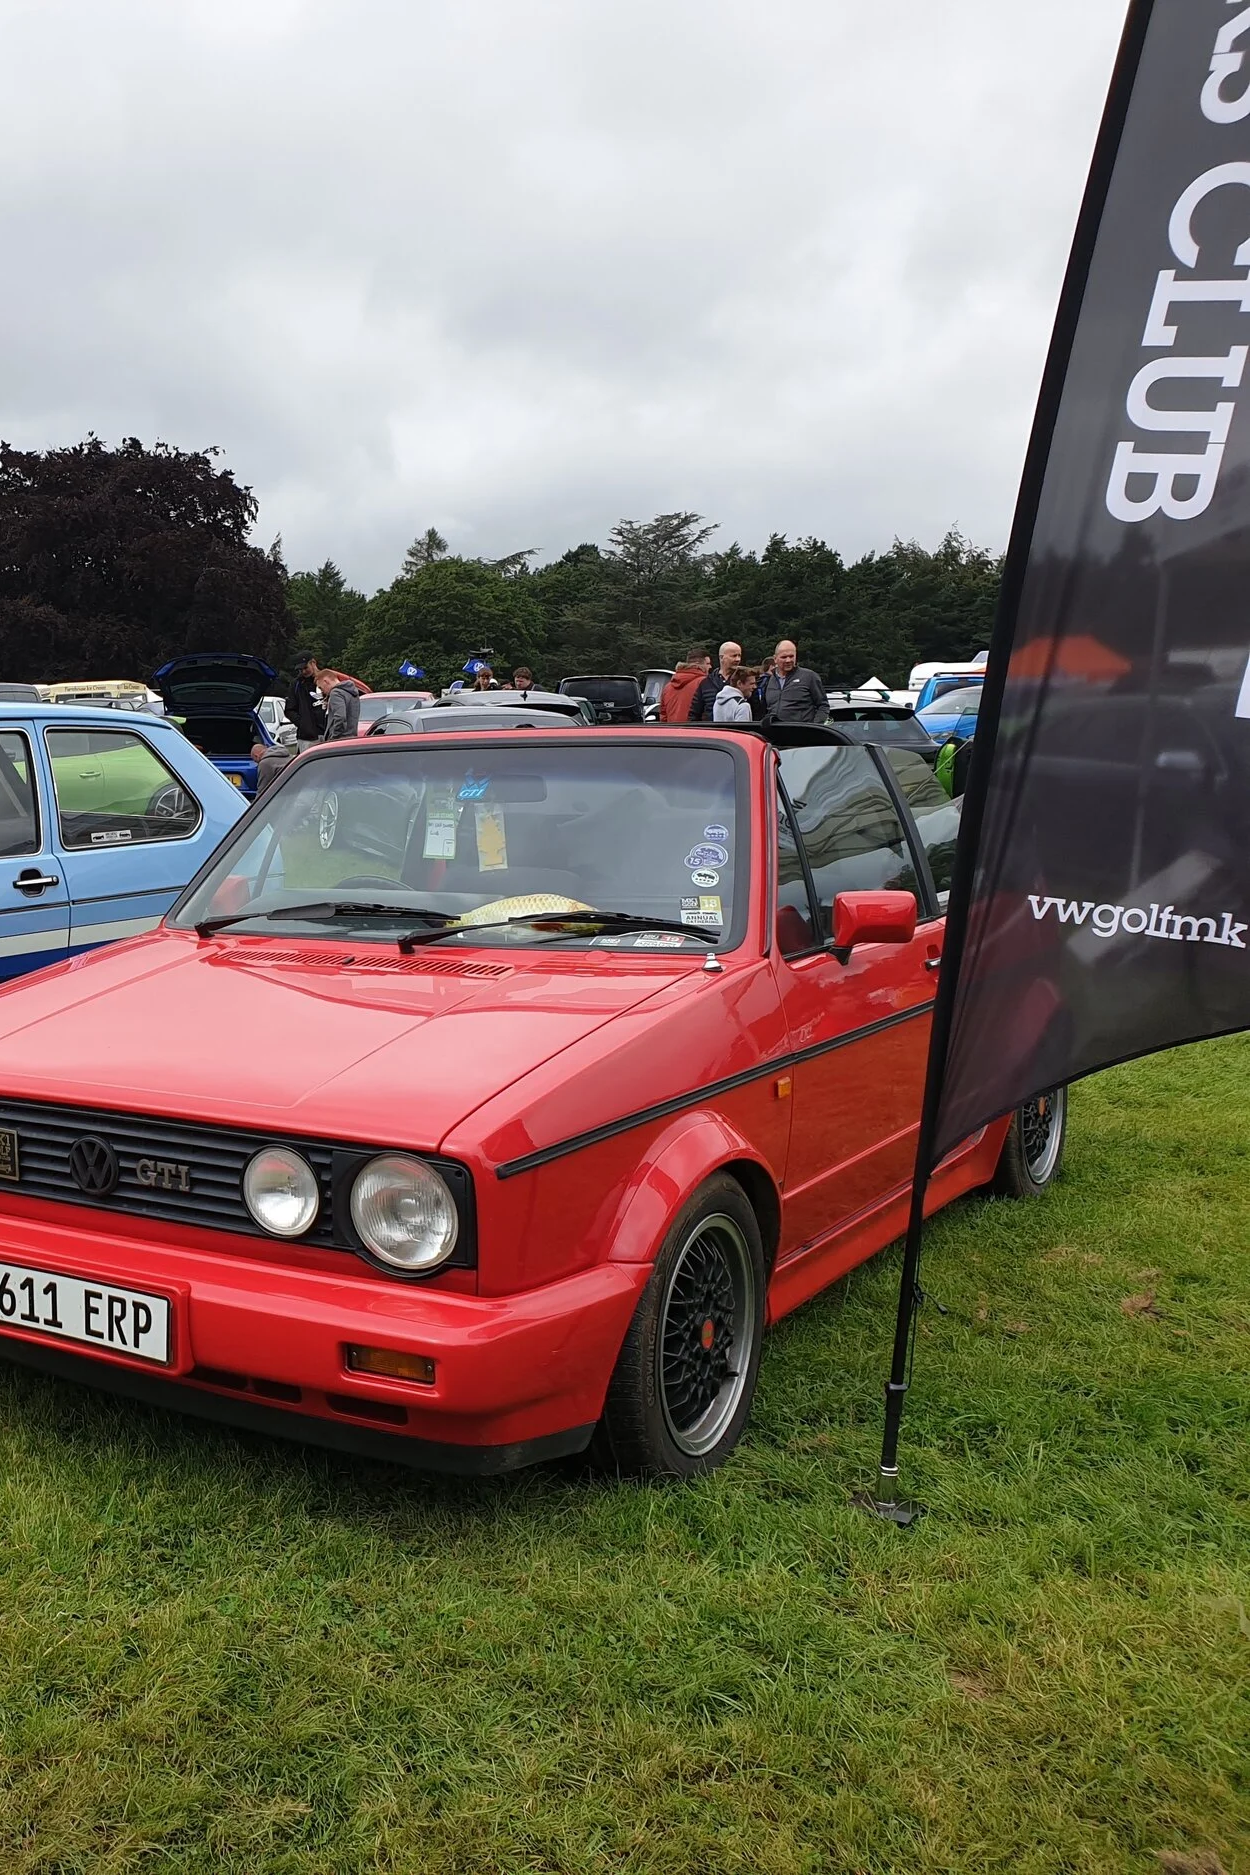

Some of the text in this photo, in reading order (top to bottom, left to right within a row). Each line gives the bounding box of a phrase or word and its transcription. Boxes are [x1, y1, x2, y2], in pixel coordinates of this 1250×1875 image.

[1106, 0, 1250, 523] S CLUB
[459, 789, 485, 797] GTI
[1027, 894, 1249, 949] vwgolfmk
[136, 1158, 191, 1192] GTI
[84, 1289, 153, 1349] ERP
